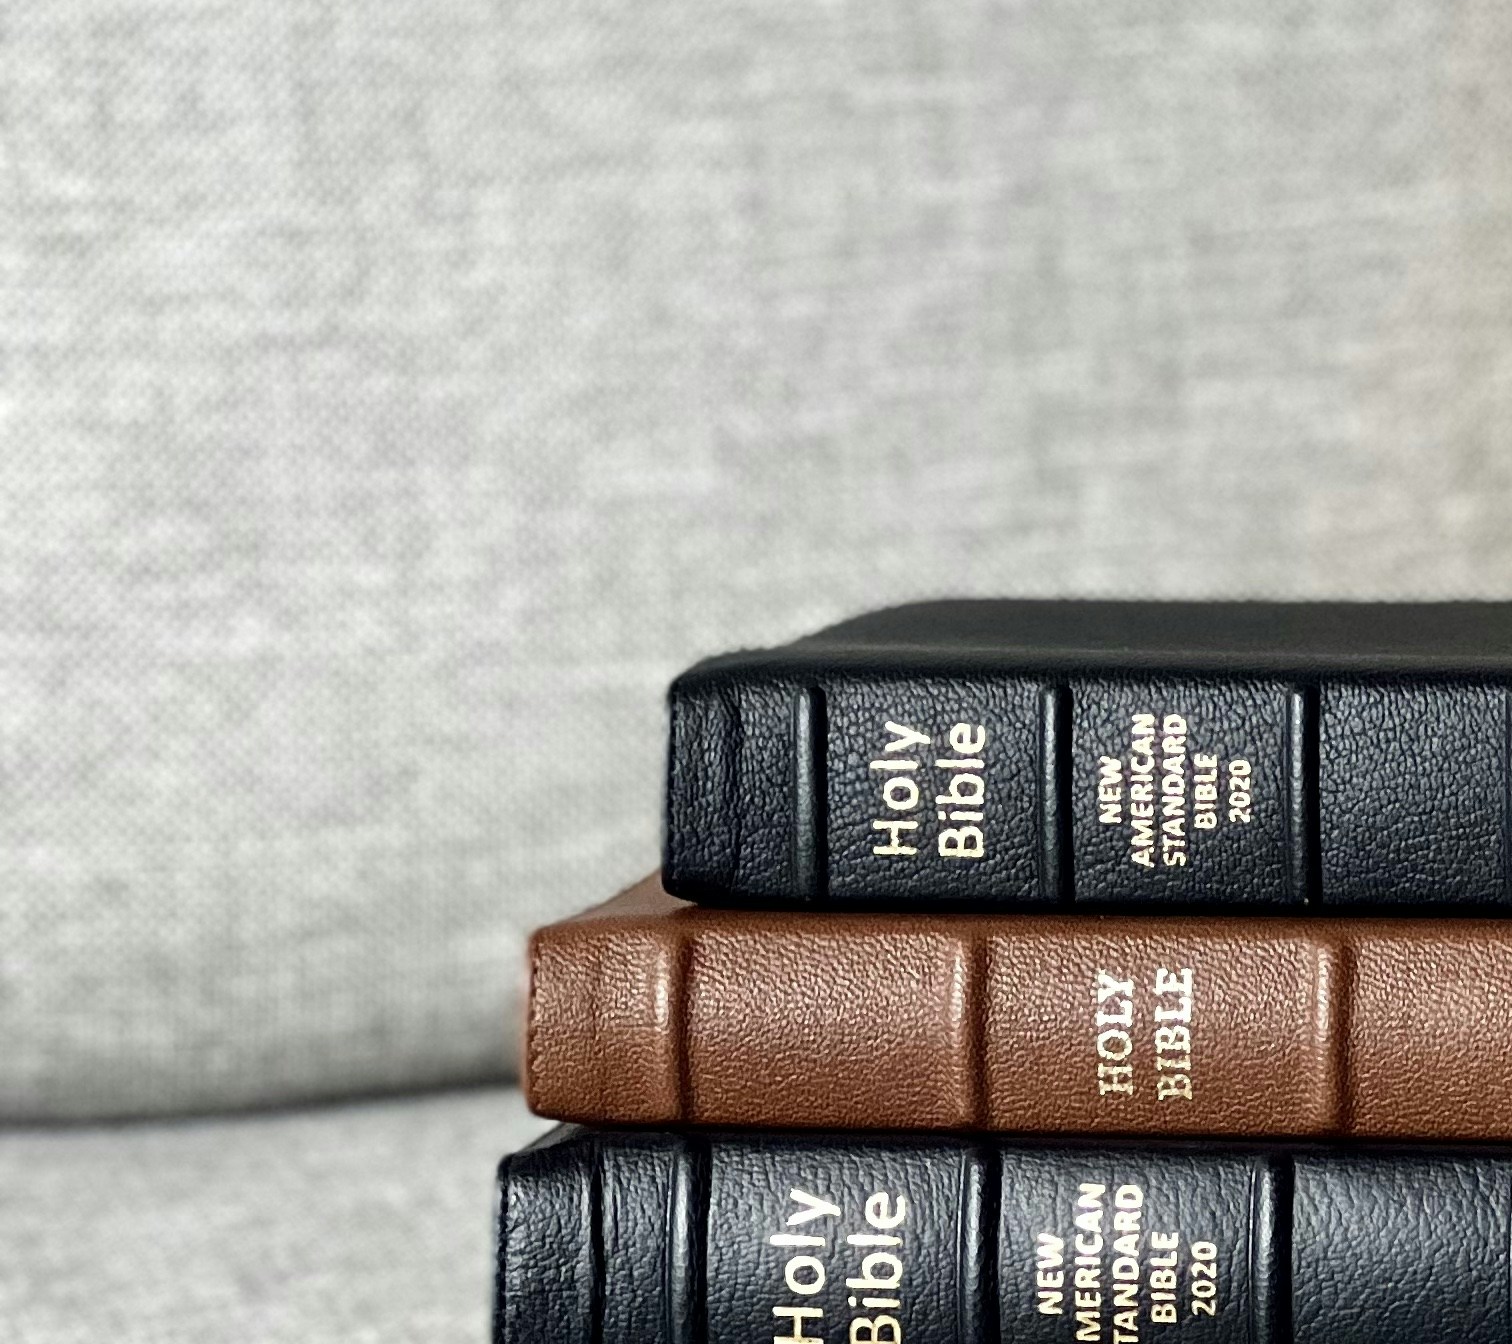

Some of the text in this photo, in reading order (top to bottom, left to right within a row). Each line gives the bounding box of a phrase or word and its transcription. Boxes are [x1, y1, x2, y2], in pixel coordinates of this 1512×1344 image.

[871, 719, 932, 857] Holy
[935, 721, 987, 859] Bible
[1097, 755, 1123, 824] NEW
[1127, 712, 1156, 868] AMERICAN
[1161, 713, 1188, 867] STANDARD
[1193, 752, 1218, 830] BIBLE
[1228, 759, 1252, 824] 2020
[1095, 969, 1135, 1097] HOLY
[1154, 966, 1193, 1101] BIBLE
[1035, 1231, 1066, 1316] NEW
[1148, 1230, 1181, 1325] BIBLE
[1189, 1240, 1219, 1317] 2020
